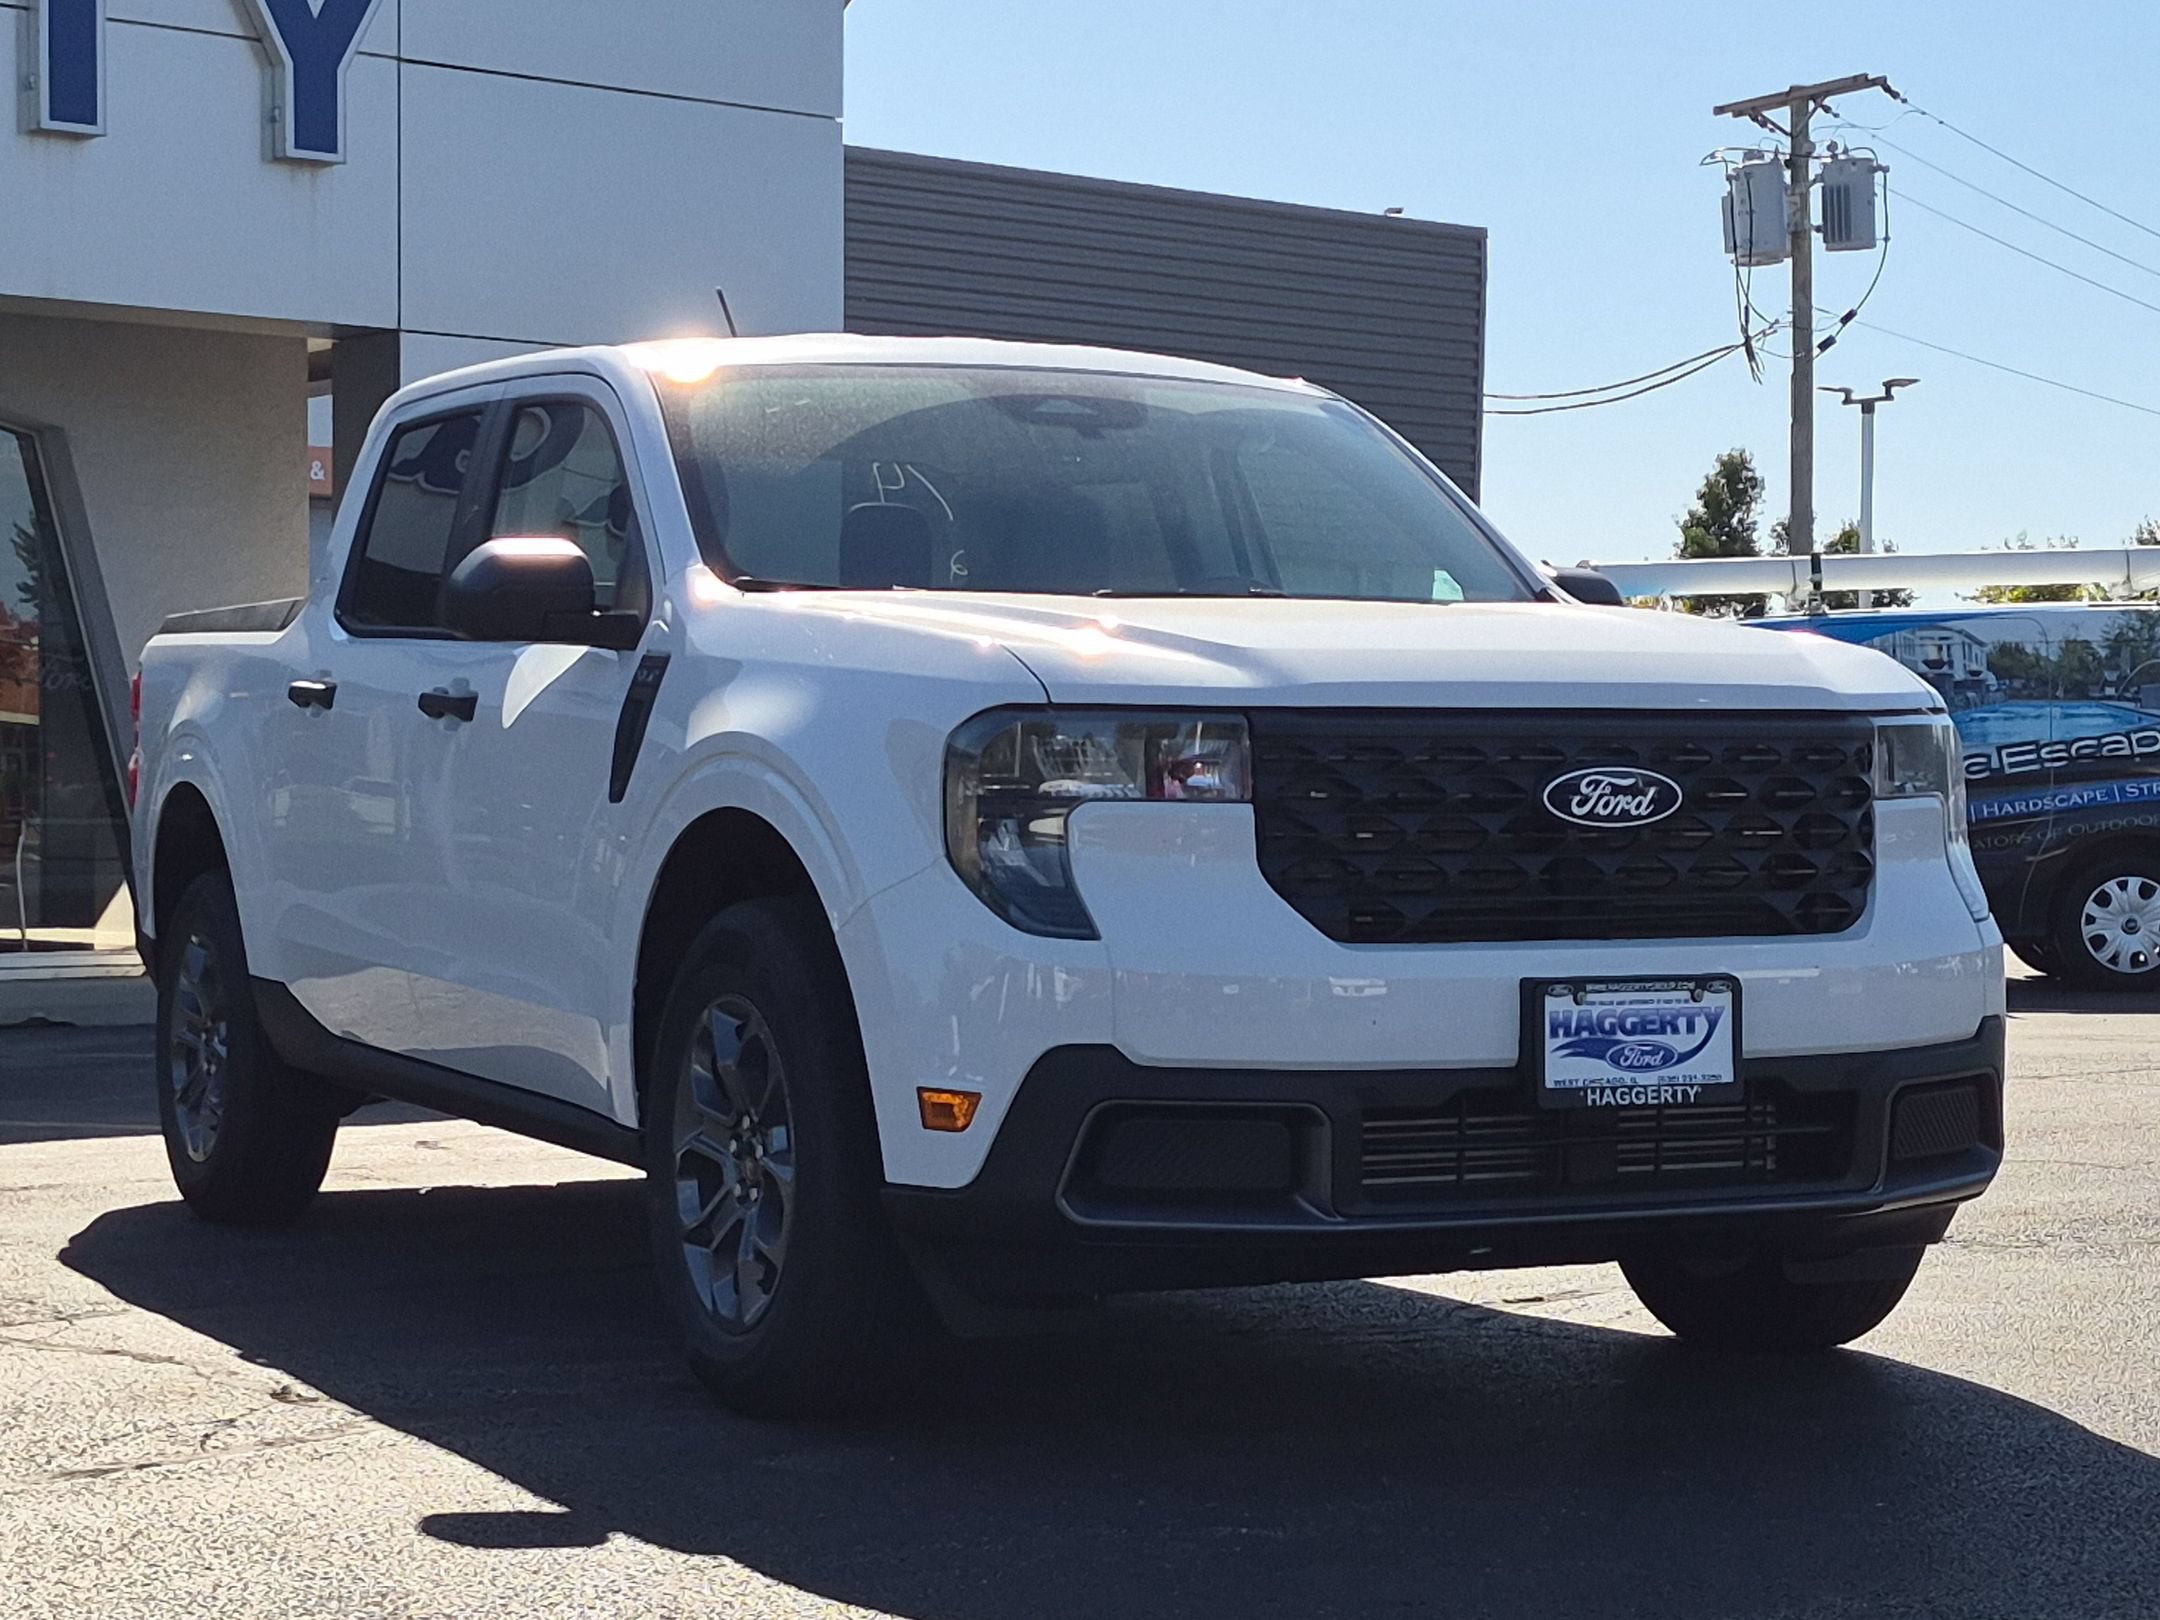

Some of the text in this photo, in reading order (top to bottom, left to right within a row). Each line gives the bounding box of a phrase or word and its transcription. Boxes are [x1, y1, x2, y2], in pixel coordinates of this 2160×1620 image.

[311, 460, 325, 480] &
[1570, 775, 1659, 816] Ford
[1983, 789, 2108, 817] HARDSCAPE
[1549, 1006, 1725, 1039] HAGGERTY
[1619, 1045, 1665, 1066] Ford
[1586, 1086, 1699, 1106] HAGGERTY
